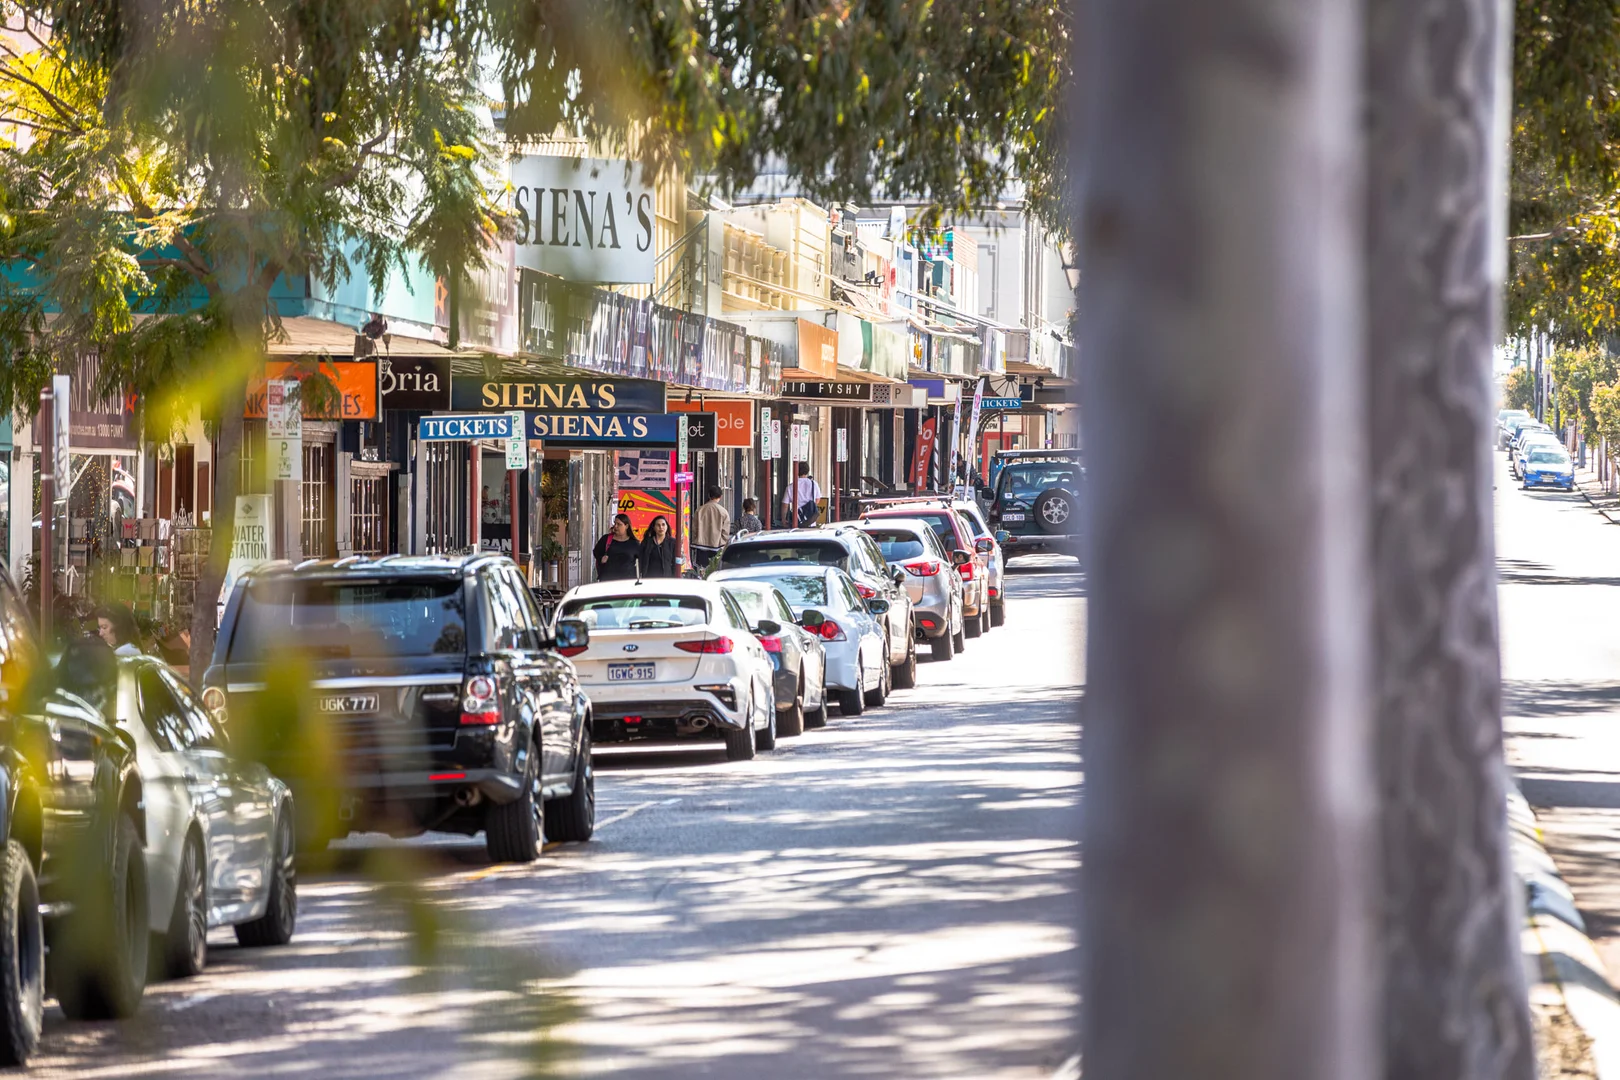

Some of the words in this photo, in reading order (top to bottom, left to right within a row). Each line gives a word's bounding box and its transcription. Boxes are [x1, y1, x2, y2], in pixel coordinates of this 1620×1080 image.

[514, 185, 652, 252] SIENA'S
[481, 382, 616, 409] SIENA'S
[818, 383, 861, 395] FYSHY
[425, 418, 508, 437] TICKETS
[533, 414, 648, 438] SIENA'S
